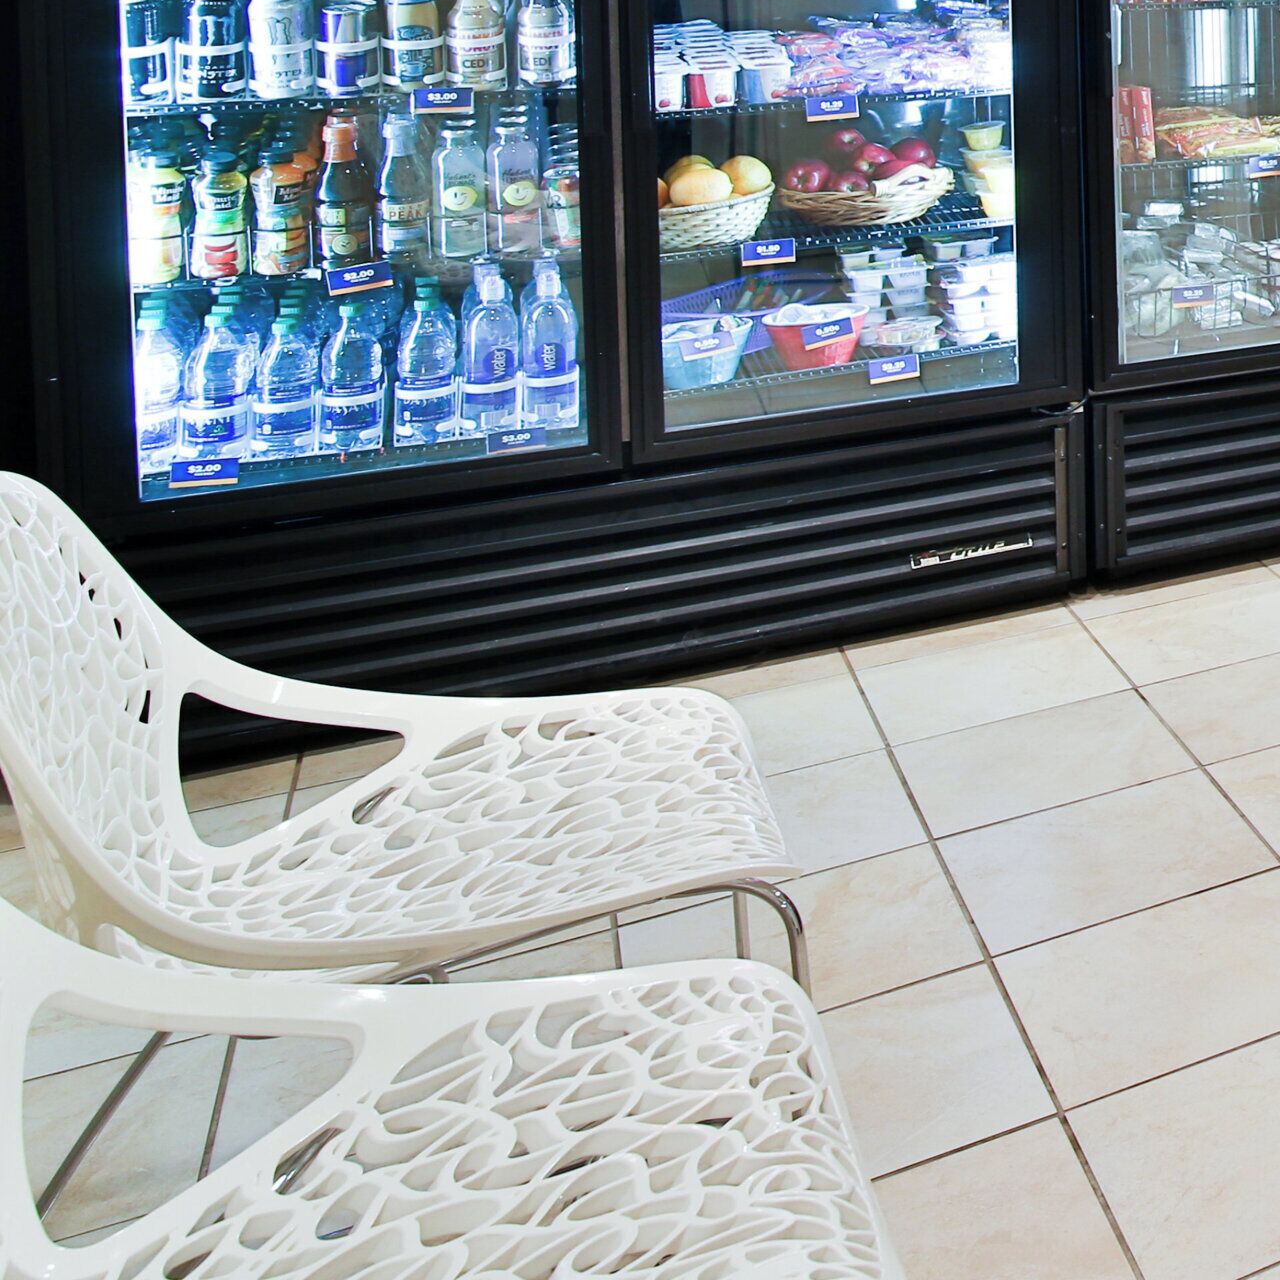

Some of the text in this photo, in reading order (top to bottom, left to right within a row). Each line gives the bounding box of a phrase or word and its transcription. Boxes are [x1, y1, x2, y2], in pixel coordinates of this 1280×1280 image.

[427, 92, 458, 102] $3.00
[152, 186, 184, 196] Minute
[154, 194, 180, 204] Maid
[388, 210, 423, 220] PEAK
[342, 268, 375, 282] $2.00
[492, 346, 506, 377] water
[542, 344, 556, 372] water
[502, 432, 531, 444] $3.00
[187, 463, 222, 474] $2.00
